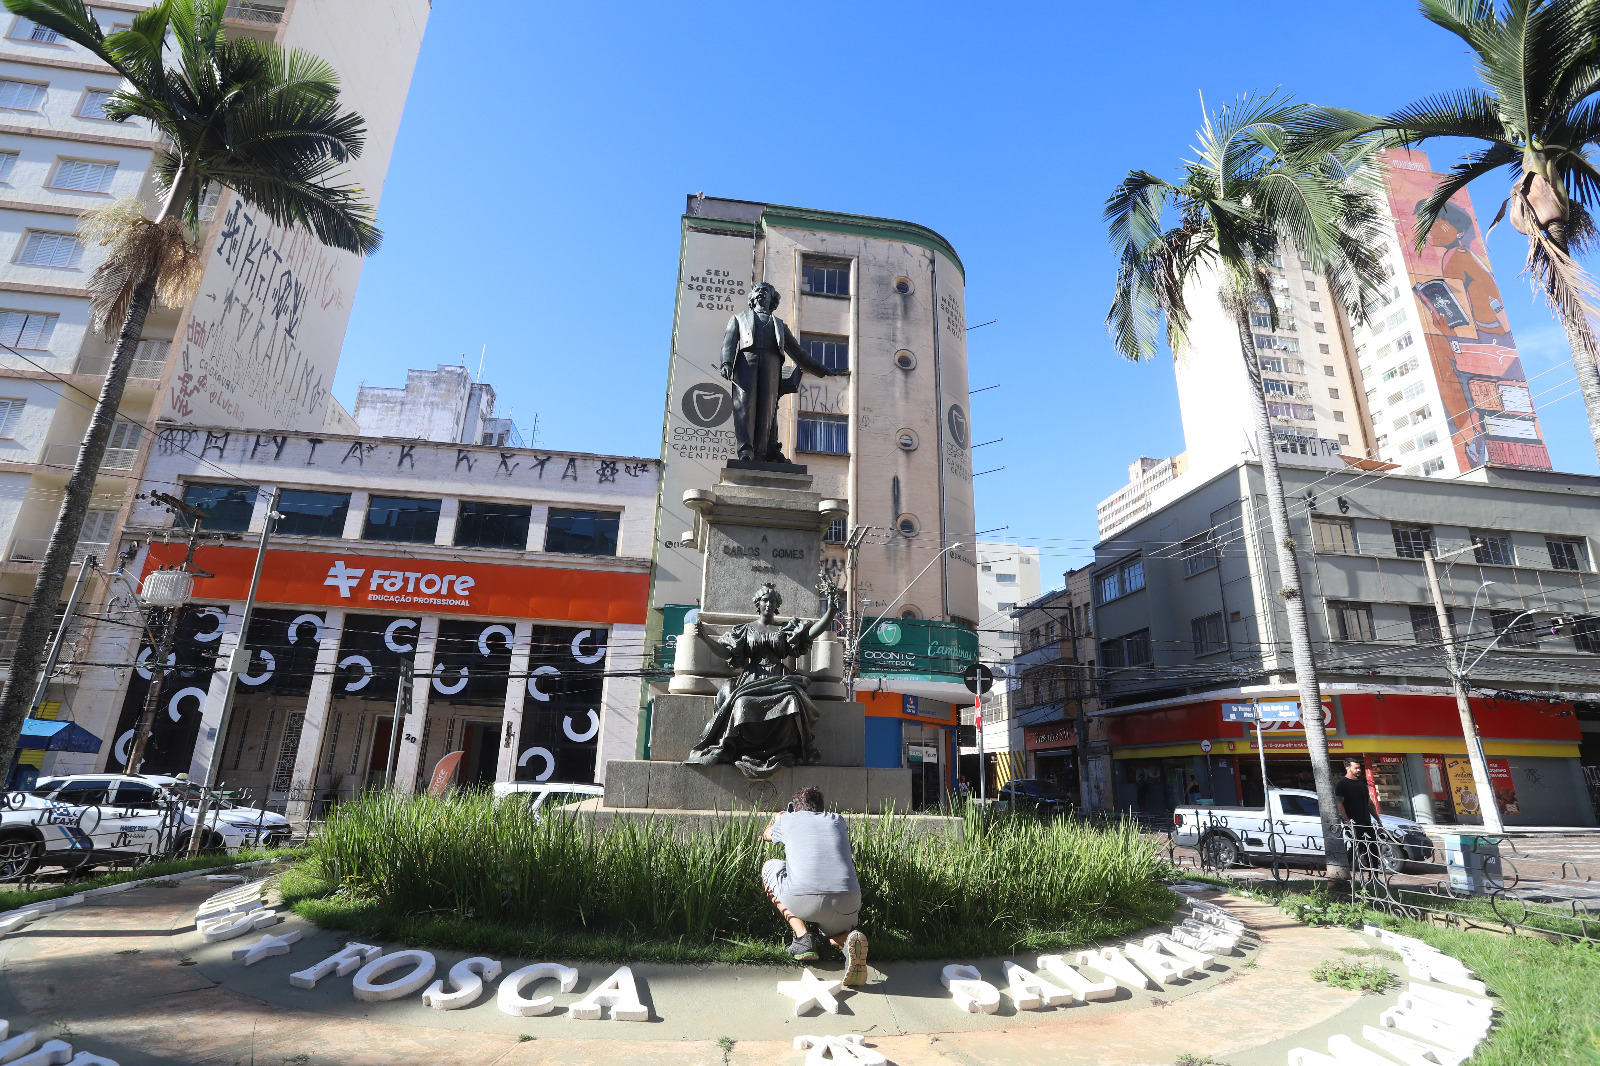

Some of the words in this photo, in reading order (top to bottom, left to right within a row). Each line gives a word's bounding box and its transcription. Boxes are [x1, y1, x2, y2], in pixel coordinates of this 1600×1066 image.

[705, 268, 730, 277] SEU
[690, 275, 744, 287] MELHOR
[687, 283, 746, 296] SORRISO
[699, 294, 732, 303] ESTÁ
[674, 426, 736, 439] ODONTO
[672, 443, 736, 455] CAMPINAS
[679, 451, 728, 461] CENTRO
[761, 534, 769, 543] A
[723, 545, 761, 557] CARLOS
[772, 548, 805, 560] GOMES
[367, 593, 412, 603] EDUCAÇÃO
[413, 596, 470, 607] PROFISSIONAL
[404, 733, 417, 744] 20
[289, 940, 650, 1022] FOSCA
